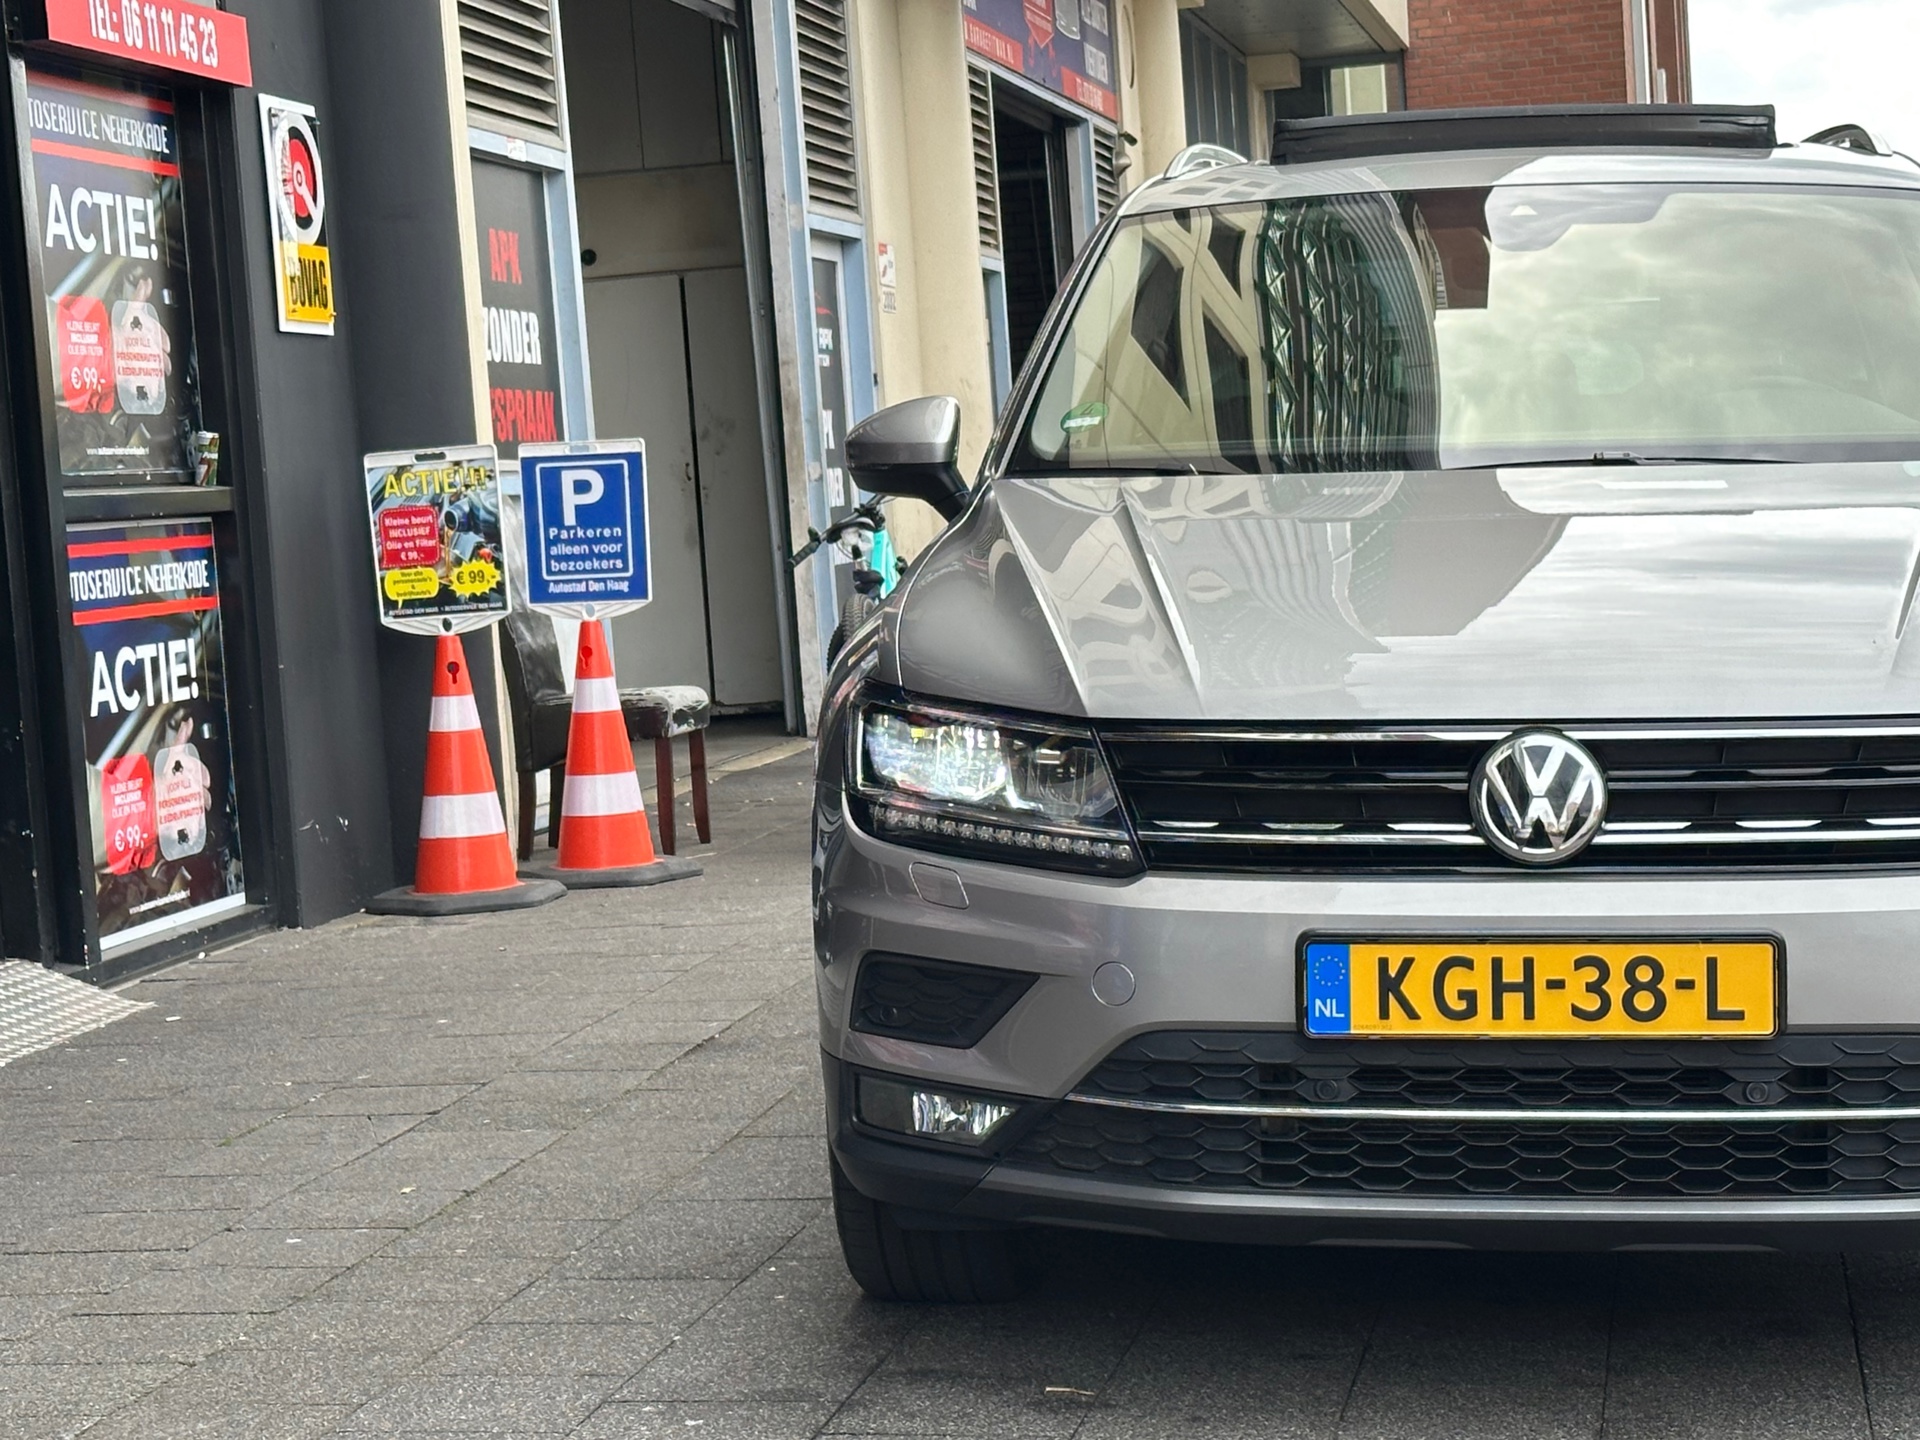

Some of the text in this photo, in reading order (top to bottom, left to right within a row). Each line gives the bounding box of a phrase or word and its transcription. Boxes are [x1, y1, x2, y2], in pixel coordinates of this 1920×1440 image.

[89, 0, 218, 68] TEL: 06 11 11 45 23
[100, 113, 170, 154] NEHERKADE
[45, 183, 159, 261] ACTIE!
[488, 227, 522, 285] APK
[71, 366, 81, 389] €
[384, 465, 487, 499] ACTIE!!!
[561, 469, 605, 527] P
[389, 526, 430, 538] INCLUSIEF
[548, 526, 622, 540] Parkeren
[549, 541, 623, 556] alleen voor
[143, 559, 210, 595] NEHERKADE
[456, 569, 497, 585] € 99,-
[550, 557, 624, 573] bezoekers
[548, 579, 630, 594] Autostad Den Haag
[90, 637, 200, 718] ACTIE!
[115, 824, 149, 852] € 99,-
[1376, 955, 1746, 1022] KGH-38-L
[1314, 999, 1345, 1018] NL
